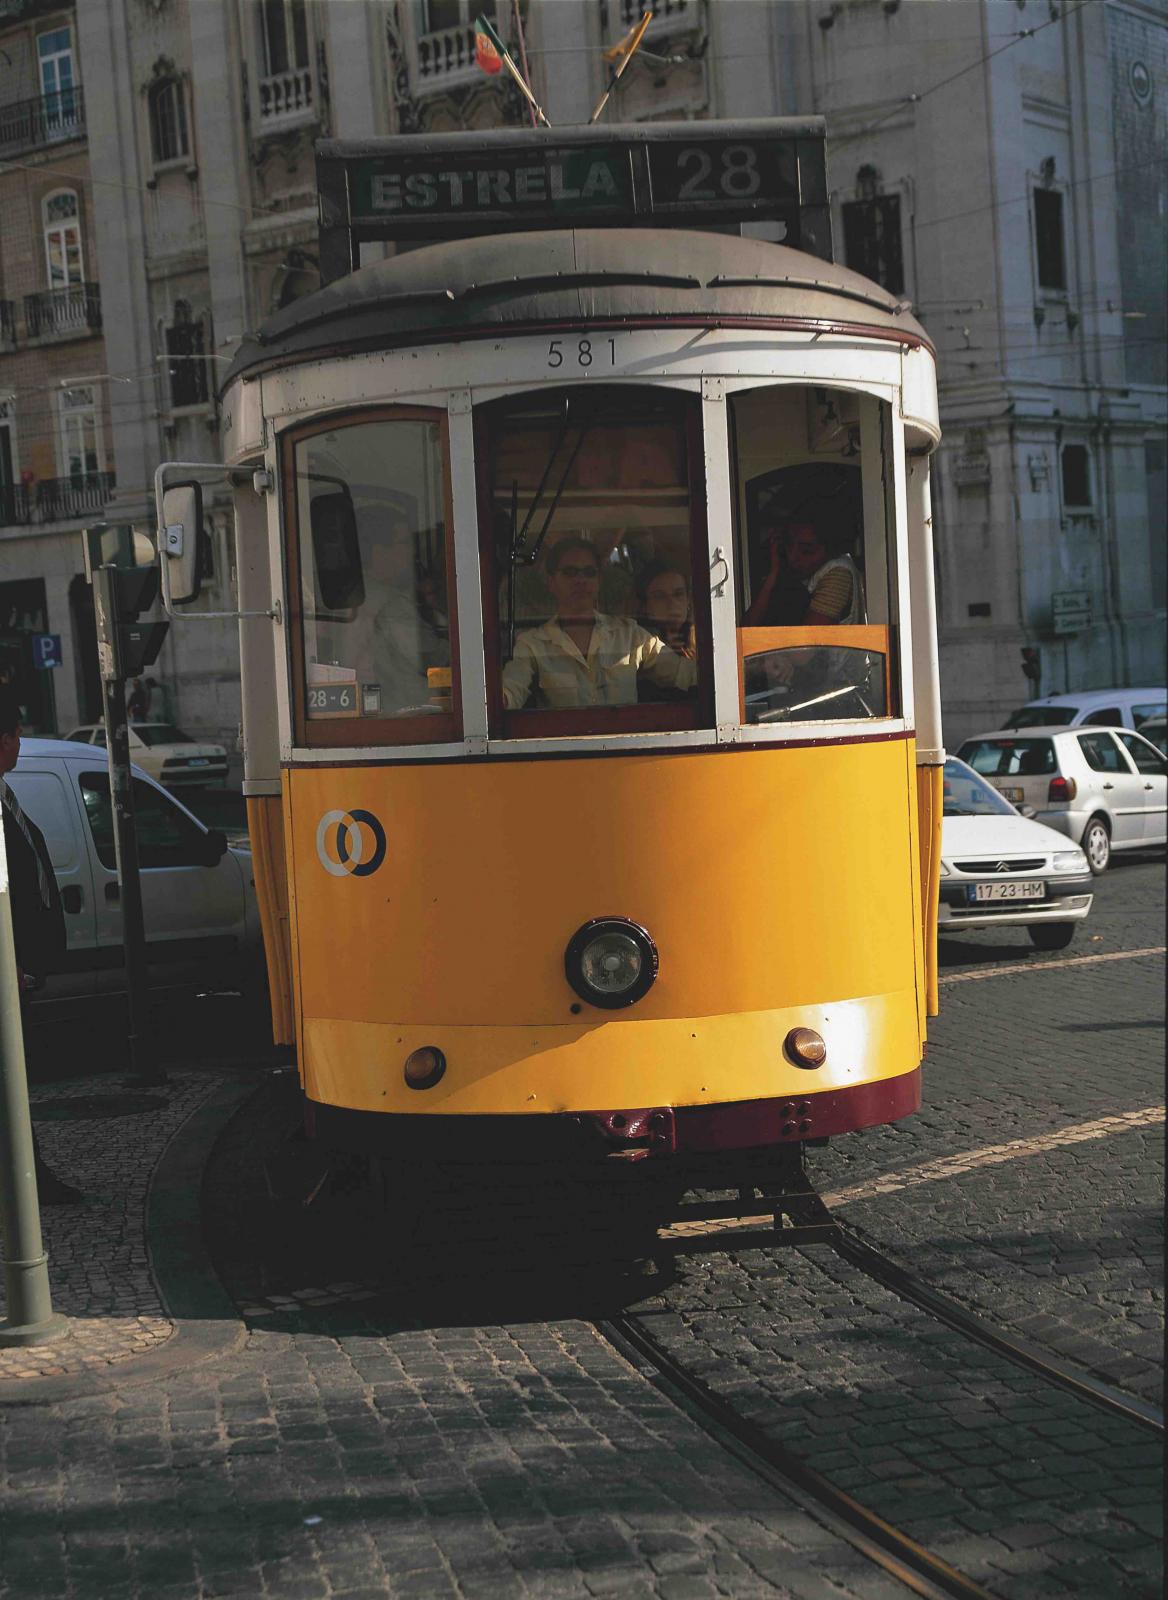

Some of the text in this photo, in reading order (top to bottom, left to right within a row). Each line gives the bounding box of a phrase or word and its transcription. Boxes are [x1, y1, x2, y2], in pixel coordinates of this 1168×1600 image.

[370, 145, 761, 209] ESTRELA 28
[41, 638, 54, 659] P
[978, 883, 1043, 898] 17-23-HM
